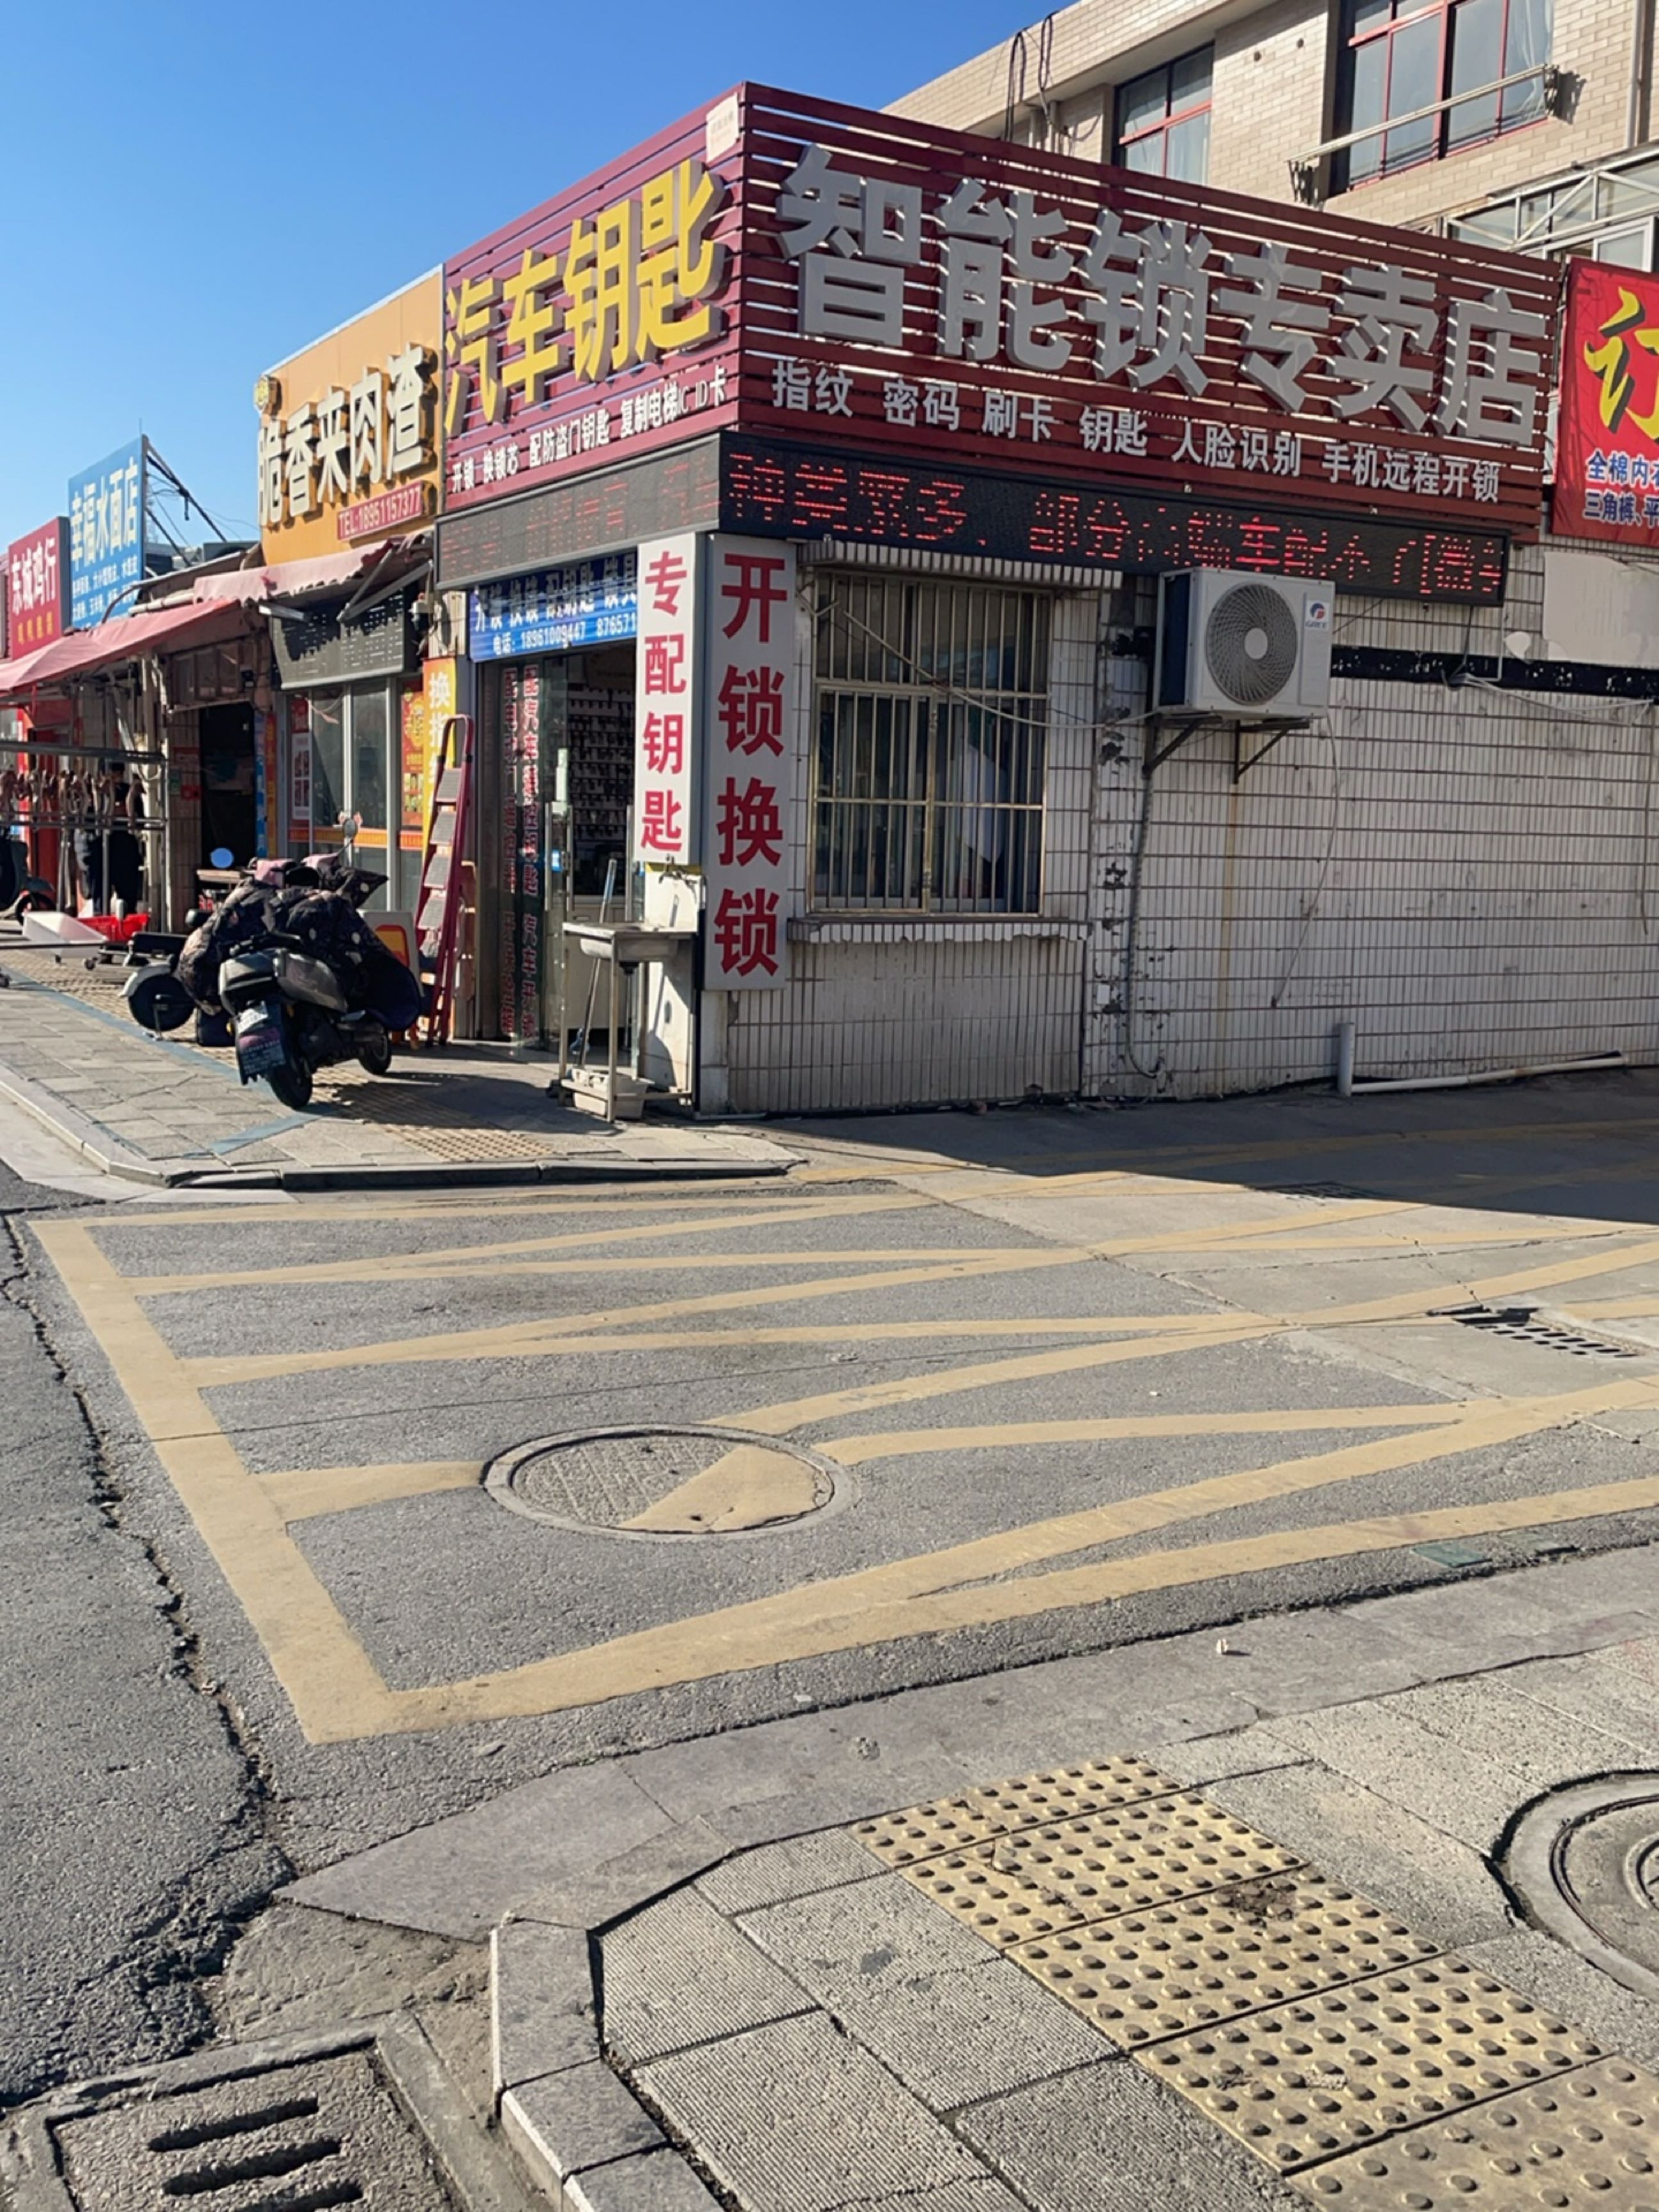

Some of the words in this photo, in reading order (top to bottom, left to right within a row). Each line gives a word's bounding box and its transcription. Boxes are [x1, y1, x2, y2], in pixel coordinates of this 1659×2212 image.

[445, 159, 718, 435] 汽车钥匙
[772, 360, 853, 417] 指纹
[883, 378, 959, 431] 密码
[982, 390, 1056, 442] 刷卡
[1079, 405, 1148, 456] 钥匙
[1171, 417, 1301, 477] 人脸识别
[1322, 442, 1500, 504] 手机远程开锁
[774, 142, 1546, 446] 智能锁专卖店
[70, 456, 138, 572] 幸福水面店
[452, 456, 475, 493] 开锁
[529, 408, 611, 468] 配防盗门钥匙
[640, 550, 687, 853] 专配钥匙
[713, 552, 789, 978] 开锁换锁
